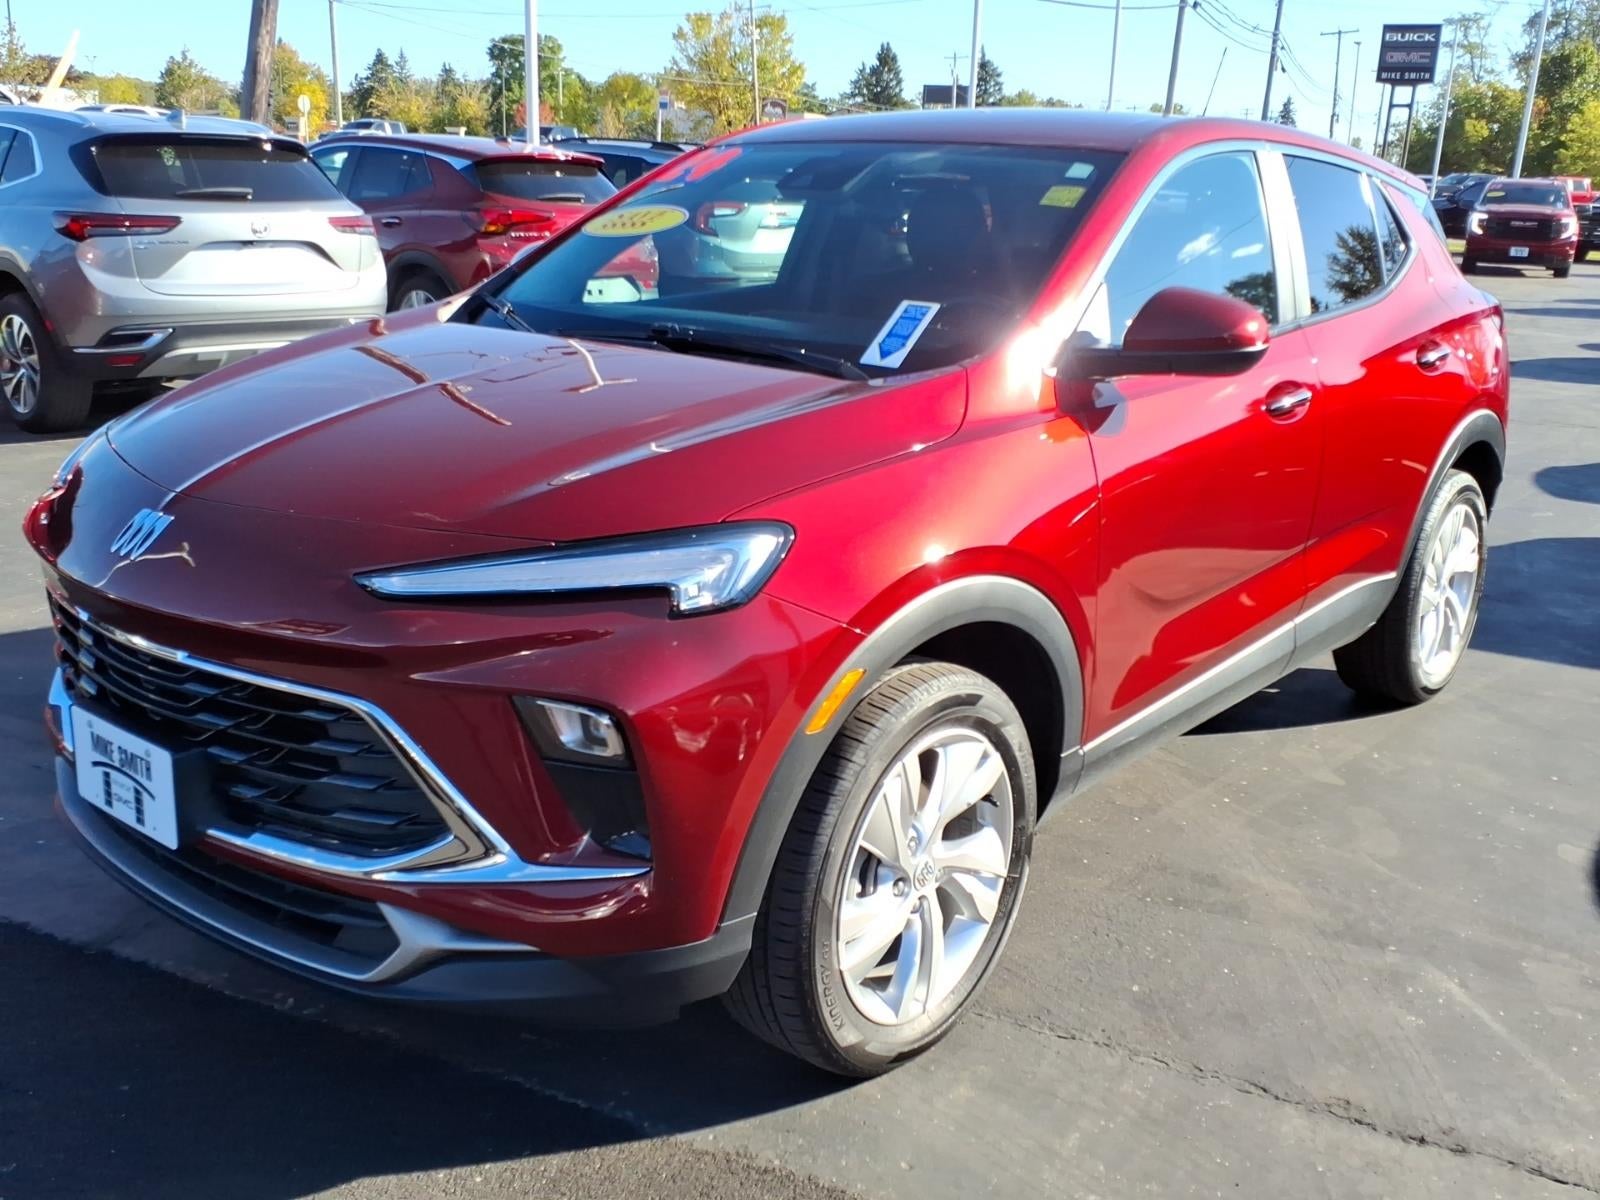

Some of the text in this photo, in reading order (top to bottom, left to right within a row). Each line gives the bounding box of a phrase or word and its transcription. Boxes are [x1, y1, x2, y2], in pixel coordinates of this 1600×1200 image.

[1385, 32, 1436, 42] BUICK
[1386, 52, 1432, 64] GMC
[1381, 71, 1431, 80] MIKE SMITH
[91, 731, 152, 783] MIKE SMITH
[820, 964, 846, 1032] KINERGY
